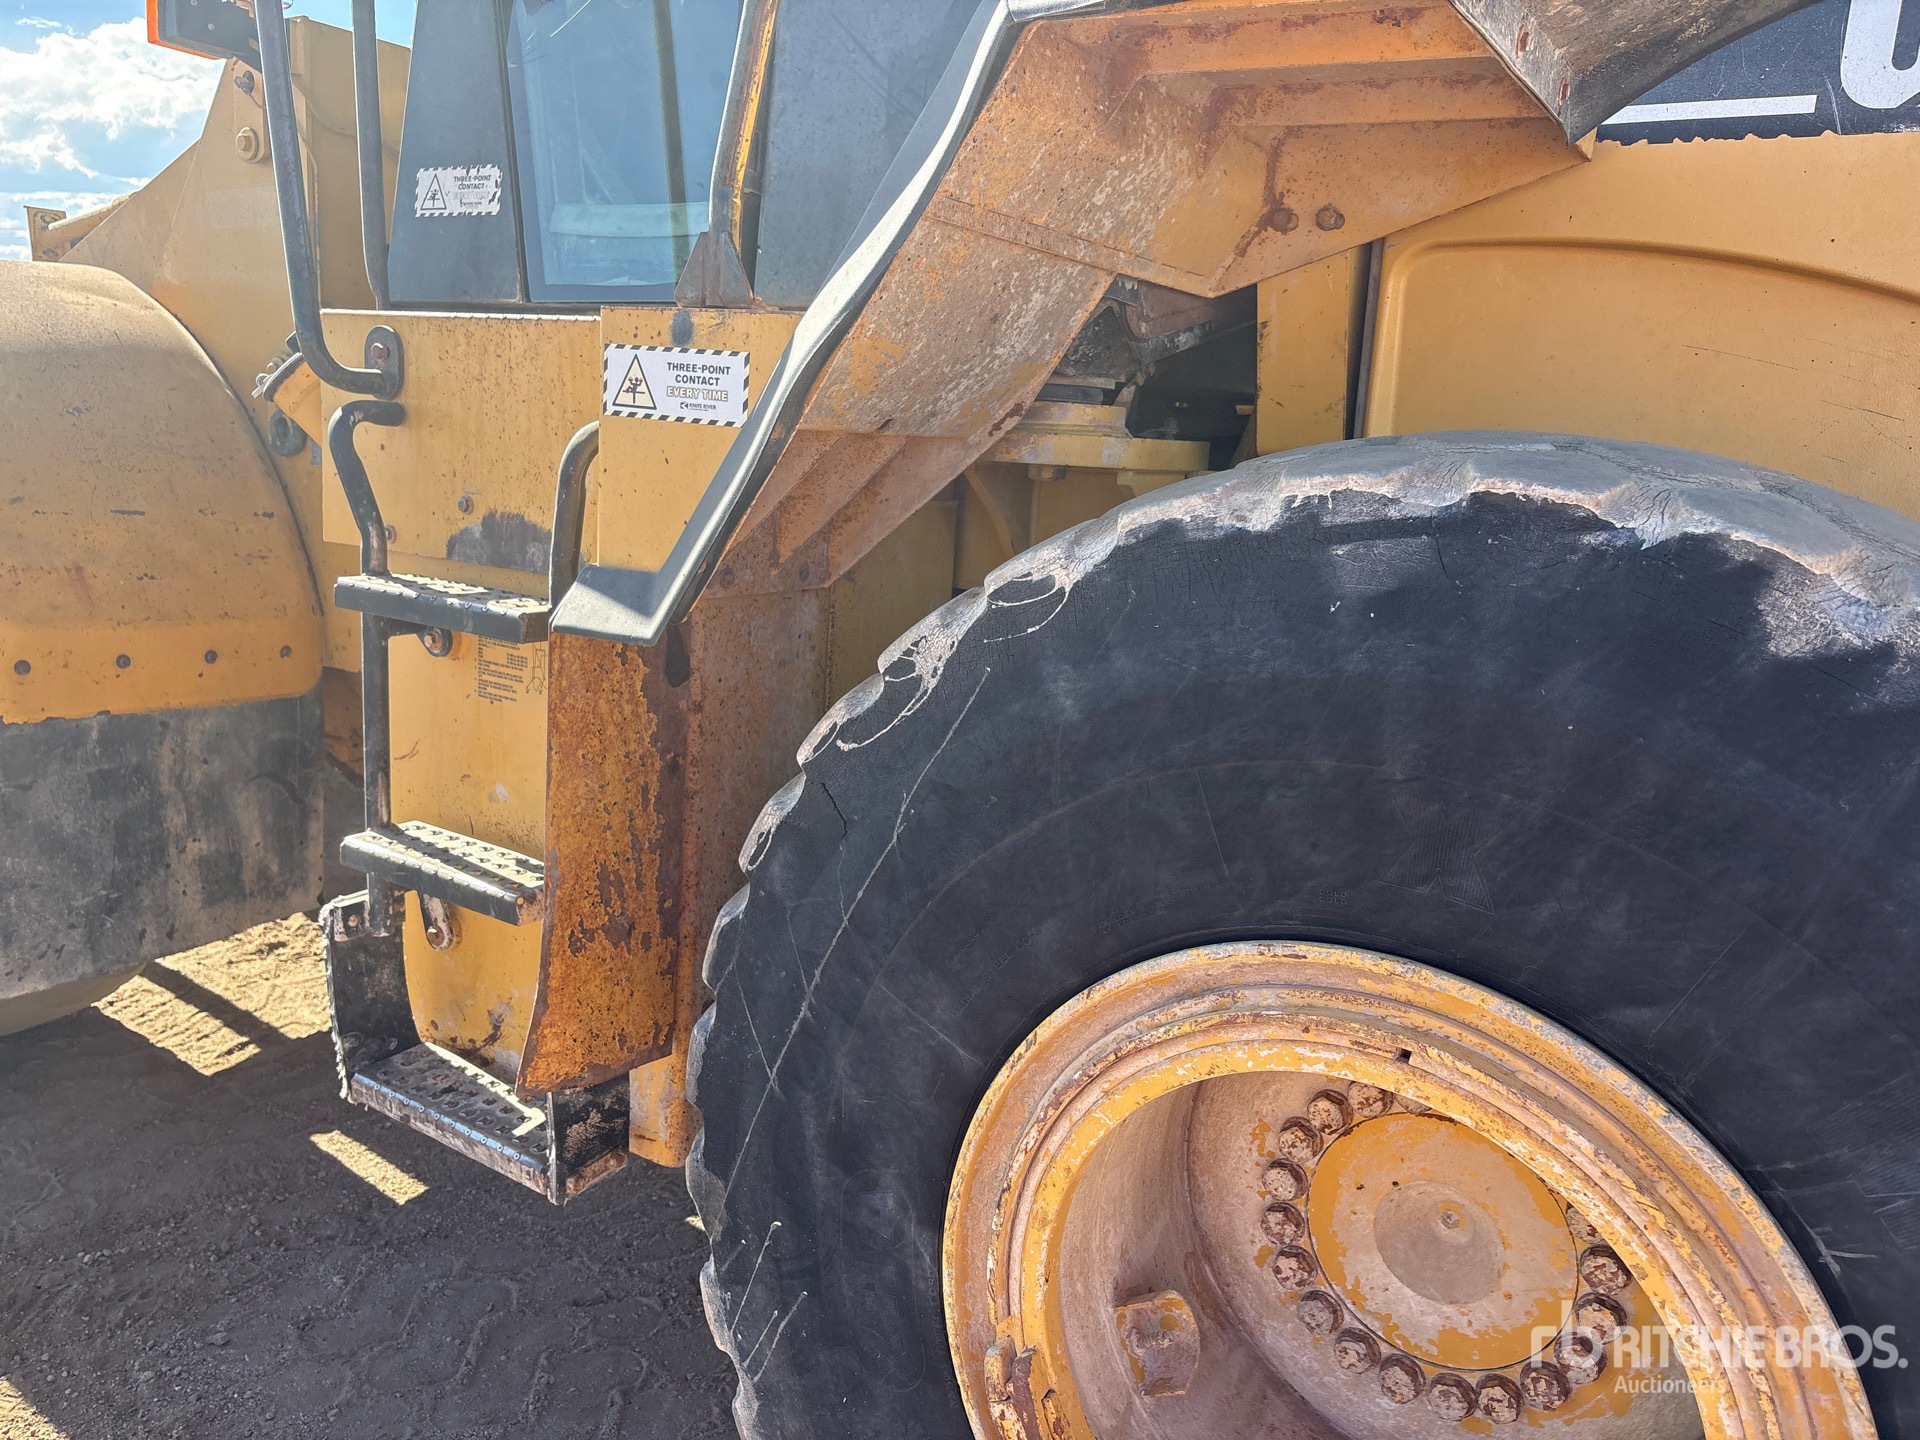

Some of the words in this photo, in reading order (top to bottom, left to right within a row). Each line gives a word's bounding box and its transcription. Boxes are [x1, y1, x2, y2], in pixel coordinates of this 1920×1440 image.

[667, 362, 731, 375] THREE-POINT
[675, 374, 720, 386] CONTACT
[667, 386, 700, 399] EVERY
[702, 389, 728, 402] TIME
